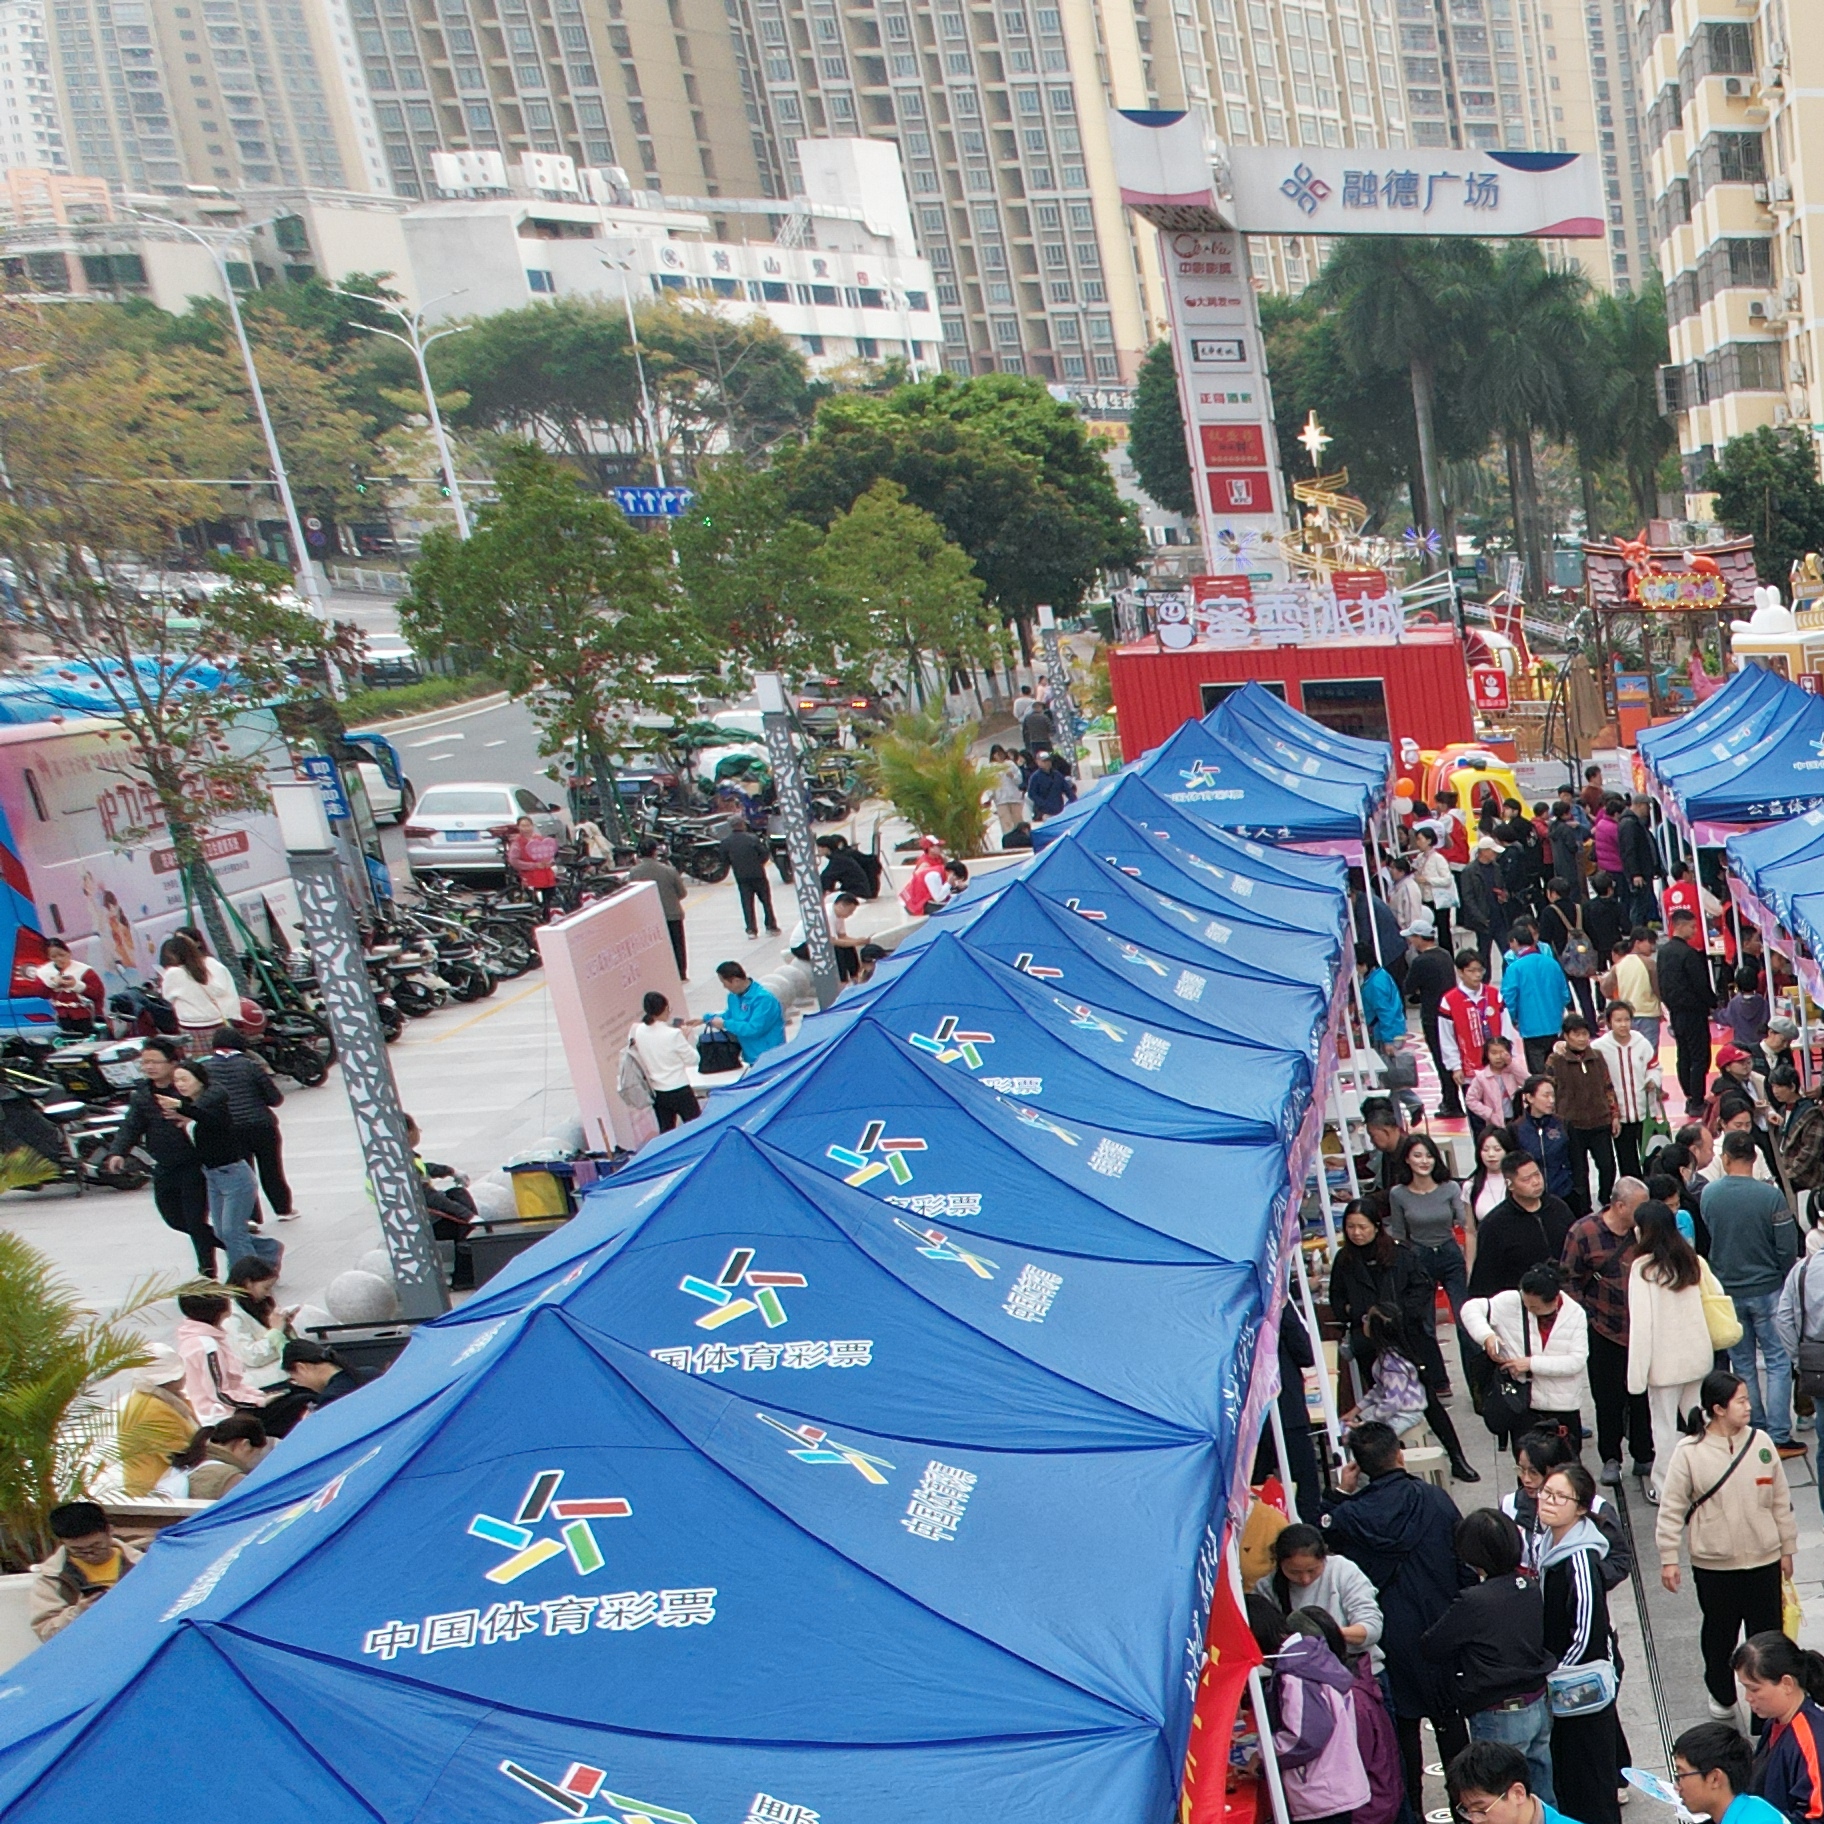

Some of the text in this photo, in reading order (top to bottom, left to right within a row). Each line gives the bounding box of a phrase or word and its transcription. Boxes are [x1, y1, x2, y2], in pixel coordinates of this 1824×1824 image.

[1342, 168, 1501, 213] 融德广场
[1198, 592, 1405, 642] 蜜雪冰城
[364, 1587, 719, 1660] 中国体育彩票
